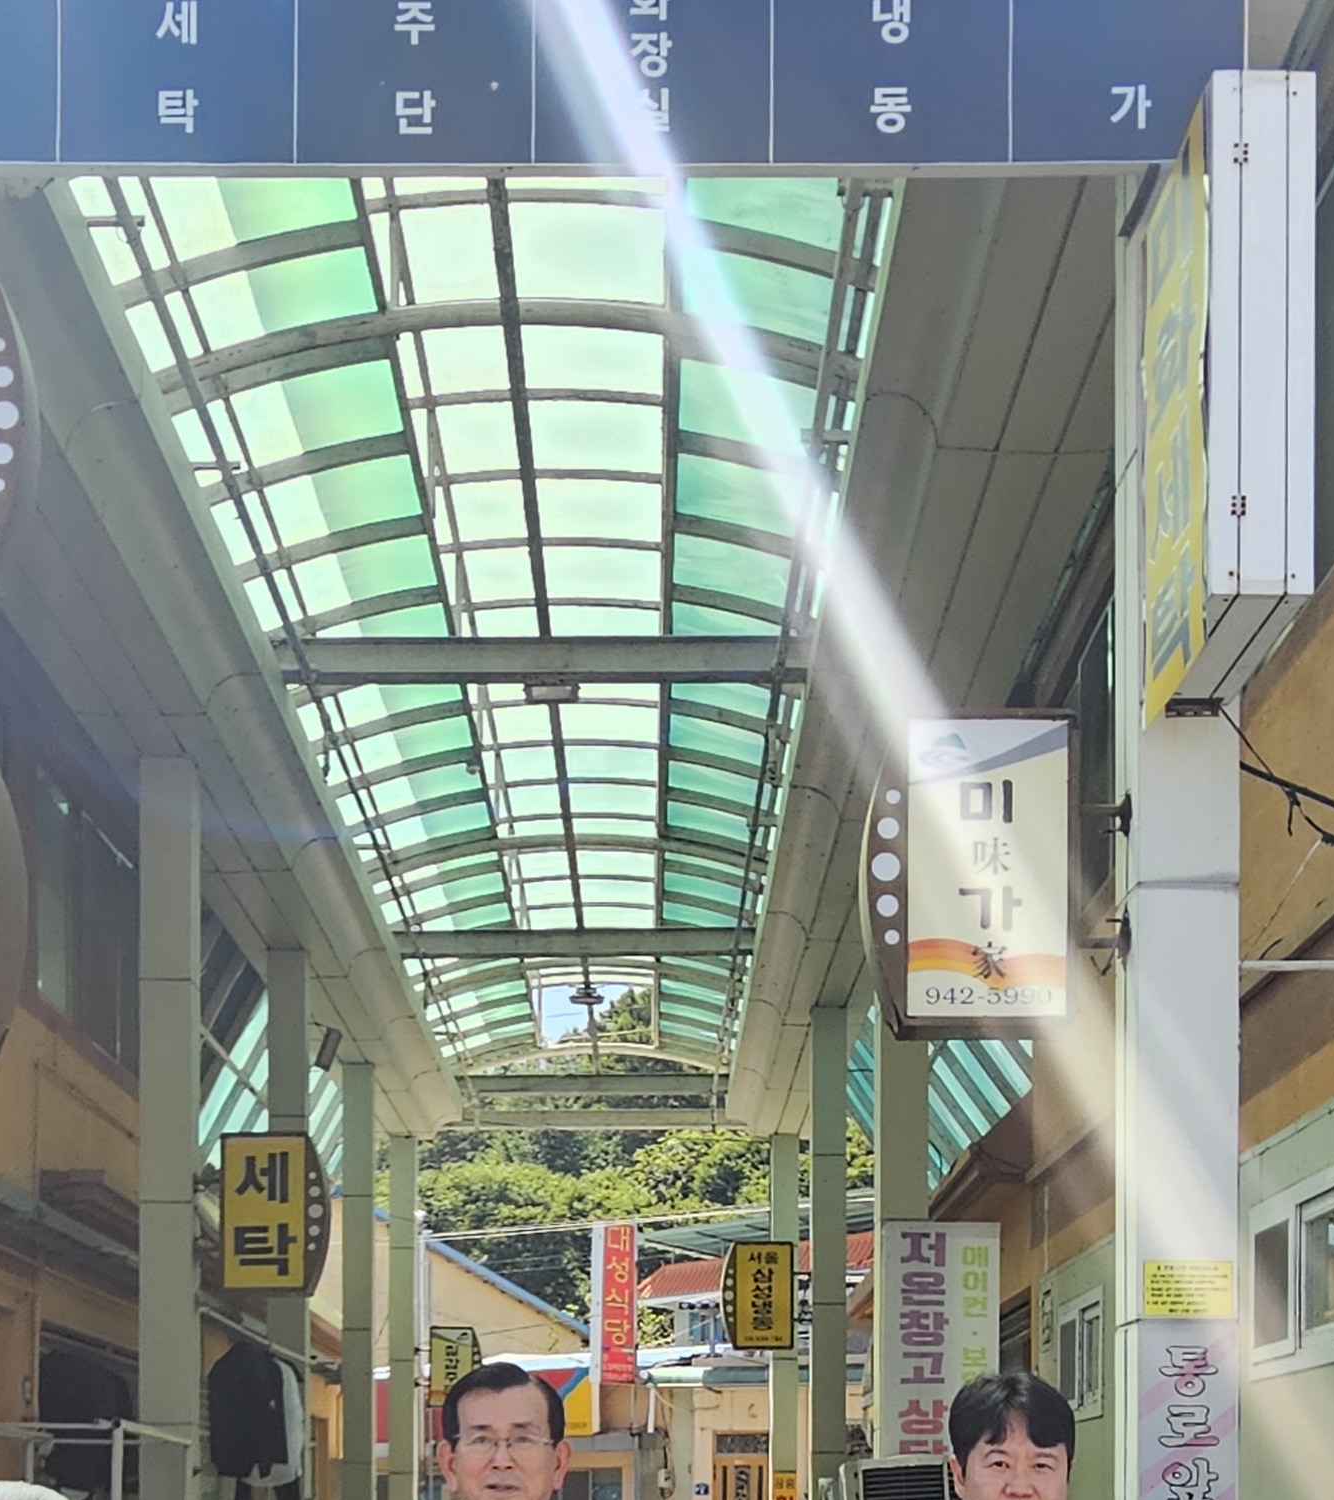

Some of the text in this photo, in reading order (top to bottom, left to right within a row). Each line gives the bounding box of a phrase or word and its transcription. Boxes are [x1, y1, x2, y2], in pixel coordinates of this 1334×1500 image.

[394, 1, 436, 134] 주단
[870, 0, 912, 133] 냉동
[925, 987, 1052, 1005] 942-5990
[234, 1151, 297, 1276] 세탁
[605, 1226, 631, 1345] 대성식당
[899, 1232, 949, 1385] 저온창고
